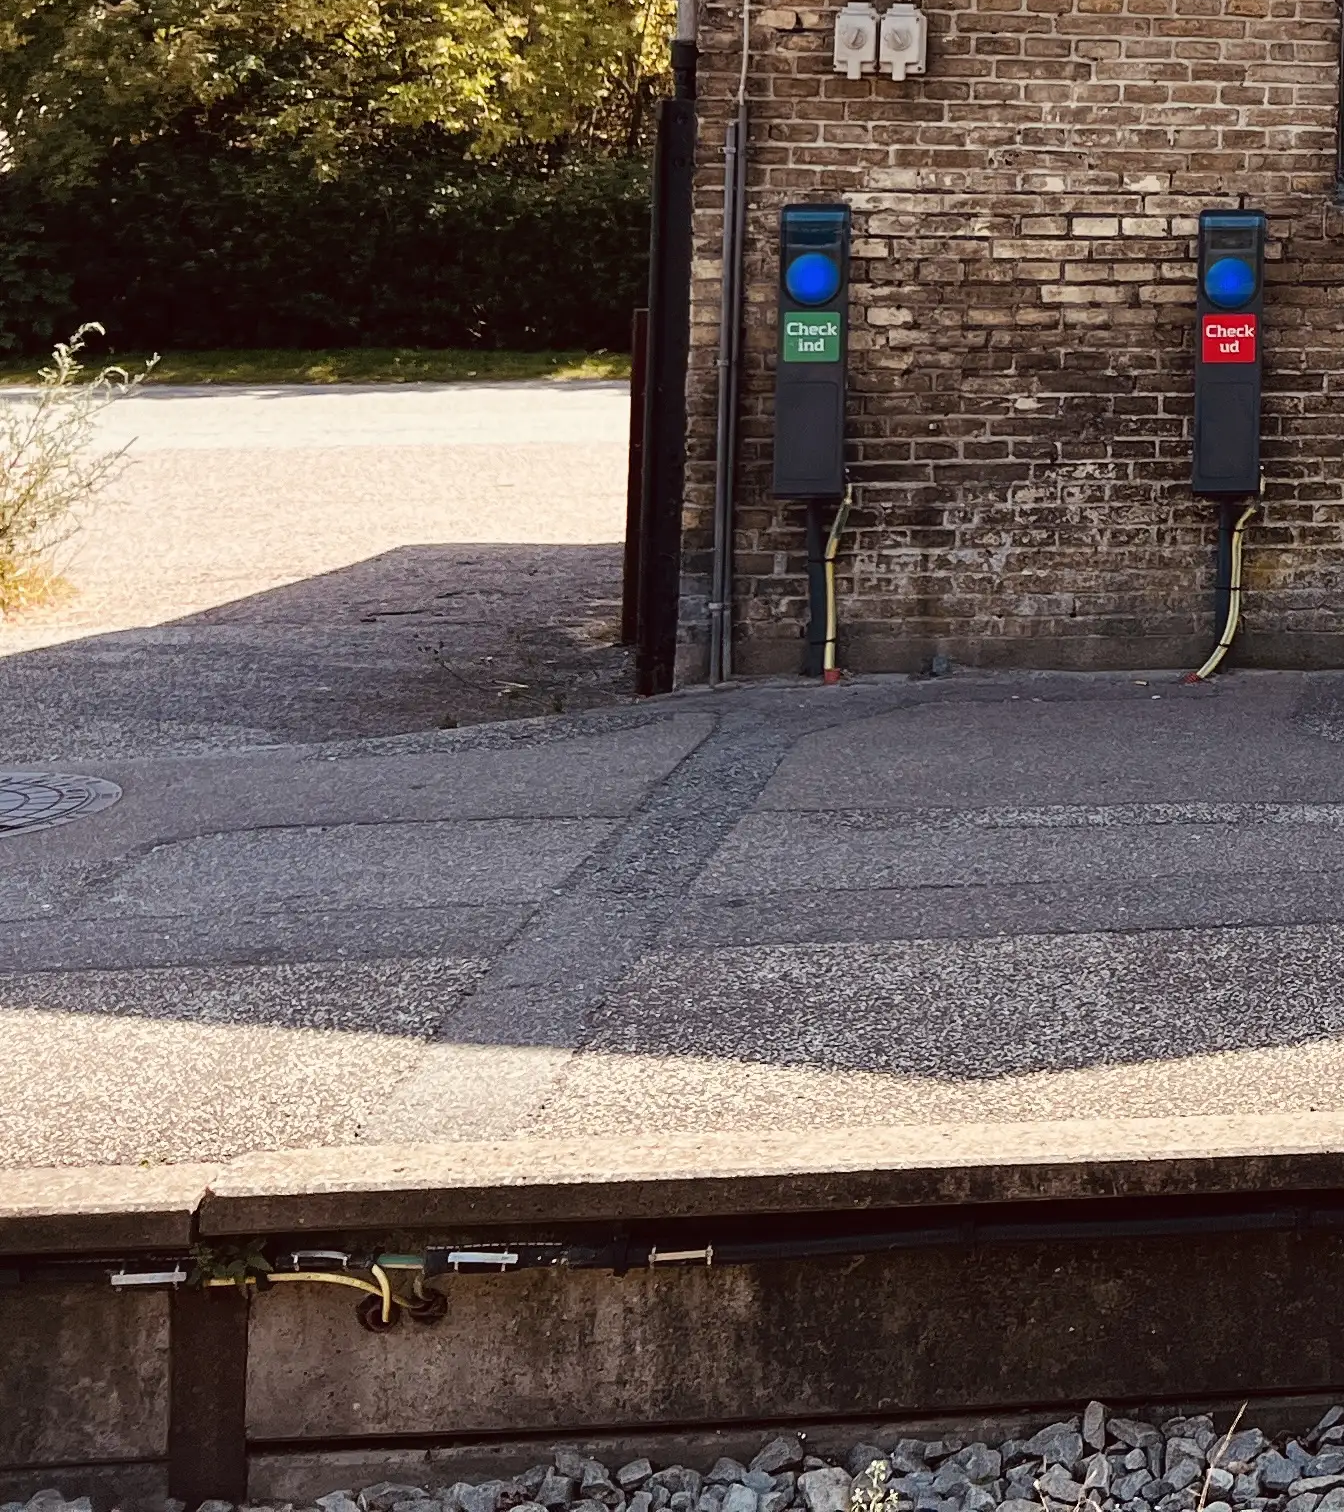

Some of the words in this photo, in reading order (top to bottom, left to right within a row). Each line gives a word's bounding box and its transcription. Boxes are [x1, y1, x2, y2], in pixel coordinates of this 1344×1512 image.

[786, 321, 838, 336] Check
[1205, 324, 1255, 338] Check
[797, 338, 825, 352] ind
[1219, 340, 1240, 353] ud
